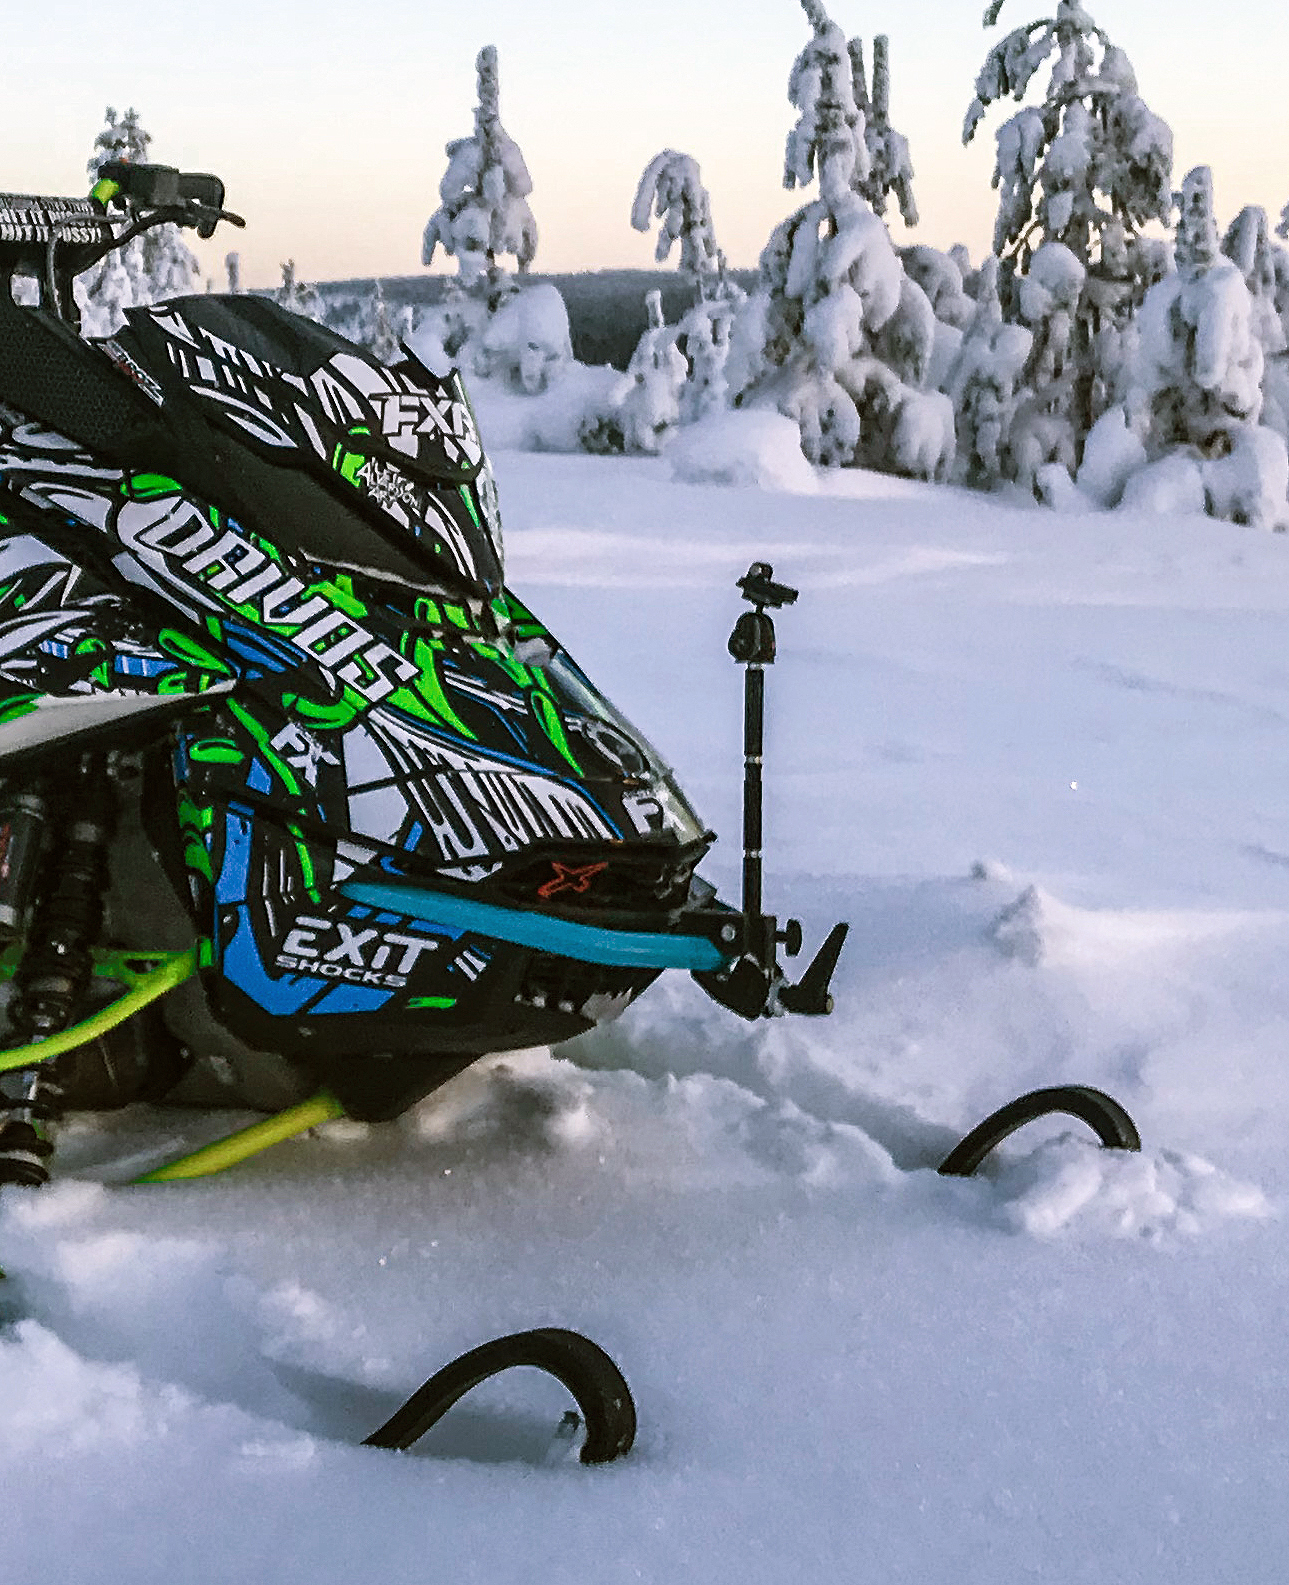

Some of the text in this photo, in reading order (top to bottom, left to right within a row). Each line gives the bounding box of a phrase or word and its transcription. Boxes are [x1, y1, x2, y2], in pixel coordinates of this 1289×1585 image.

[0, 223, 33, 241] HIT
[381, 395, 480, 441] FXR
[275, 954, 408, 988] SHOCKS
